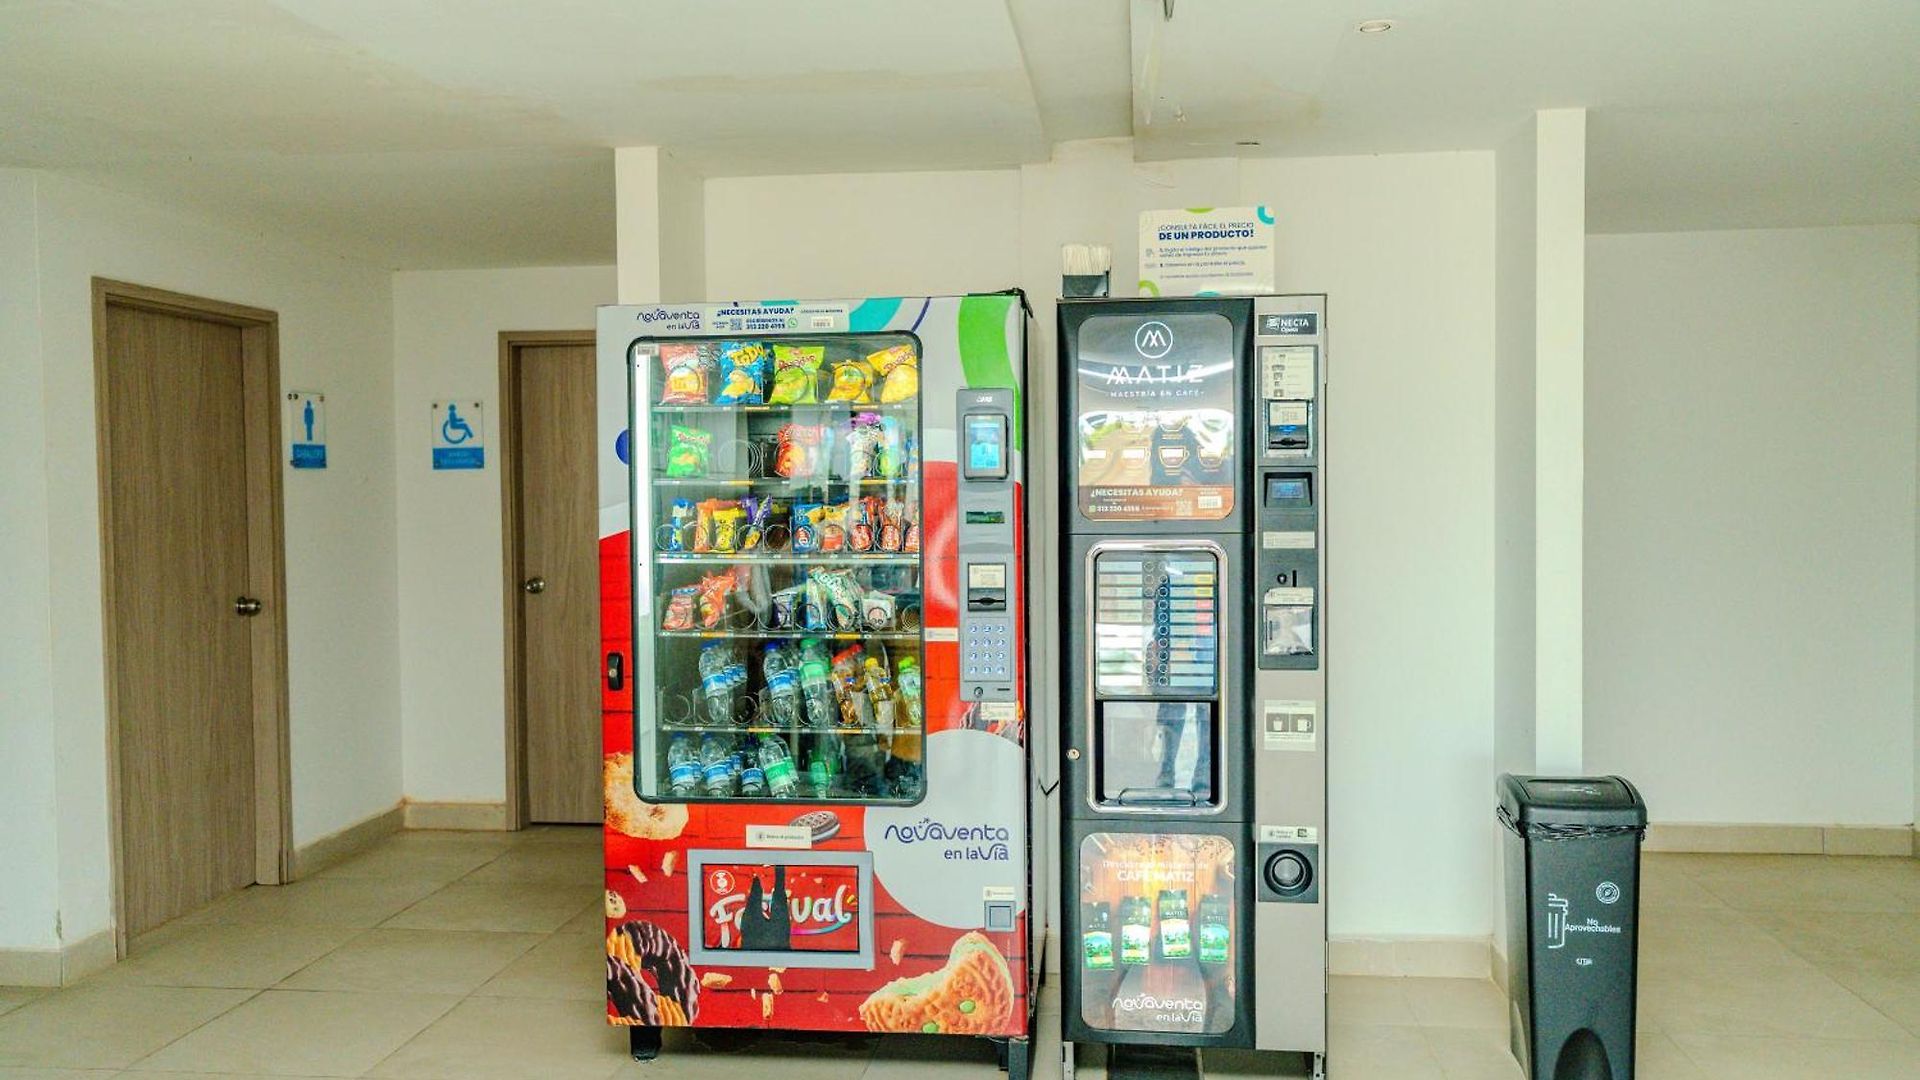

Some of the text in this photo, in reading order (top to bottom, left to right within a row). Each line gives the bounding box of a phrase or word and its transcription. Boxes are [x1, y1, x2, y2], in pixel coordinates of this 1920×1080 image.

[1159, 229, 1255, 240] DE UN PRODUCTO!
[717, 309, 762, 317] ¿NECESITAS
[763, 307, 795, 315] AYUDA?
[1280, 319, 1310, 327] NECTA
[1090, 487, 1183, 498] ¿NECESITAS AYUDA?
[944, 849, 962, 860] en
[709, 884, 852, 949] Fval
[1586, 918, 1598, 926] No
